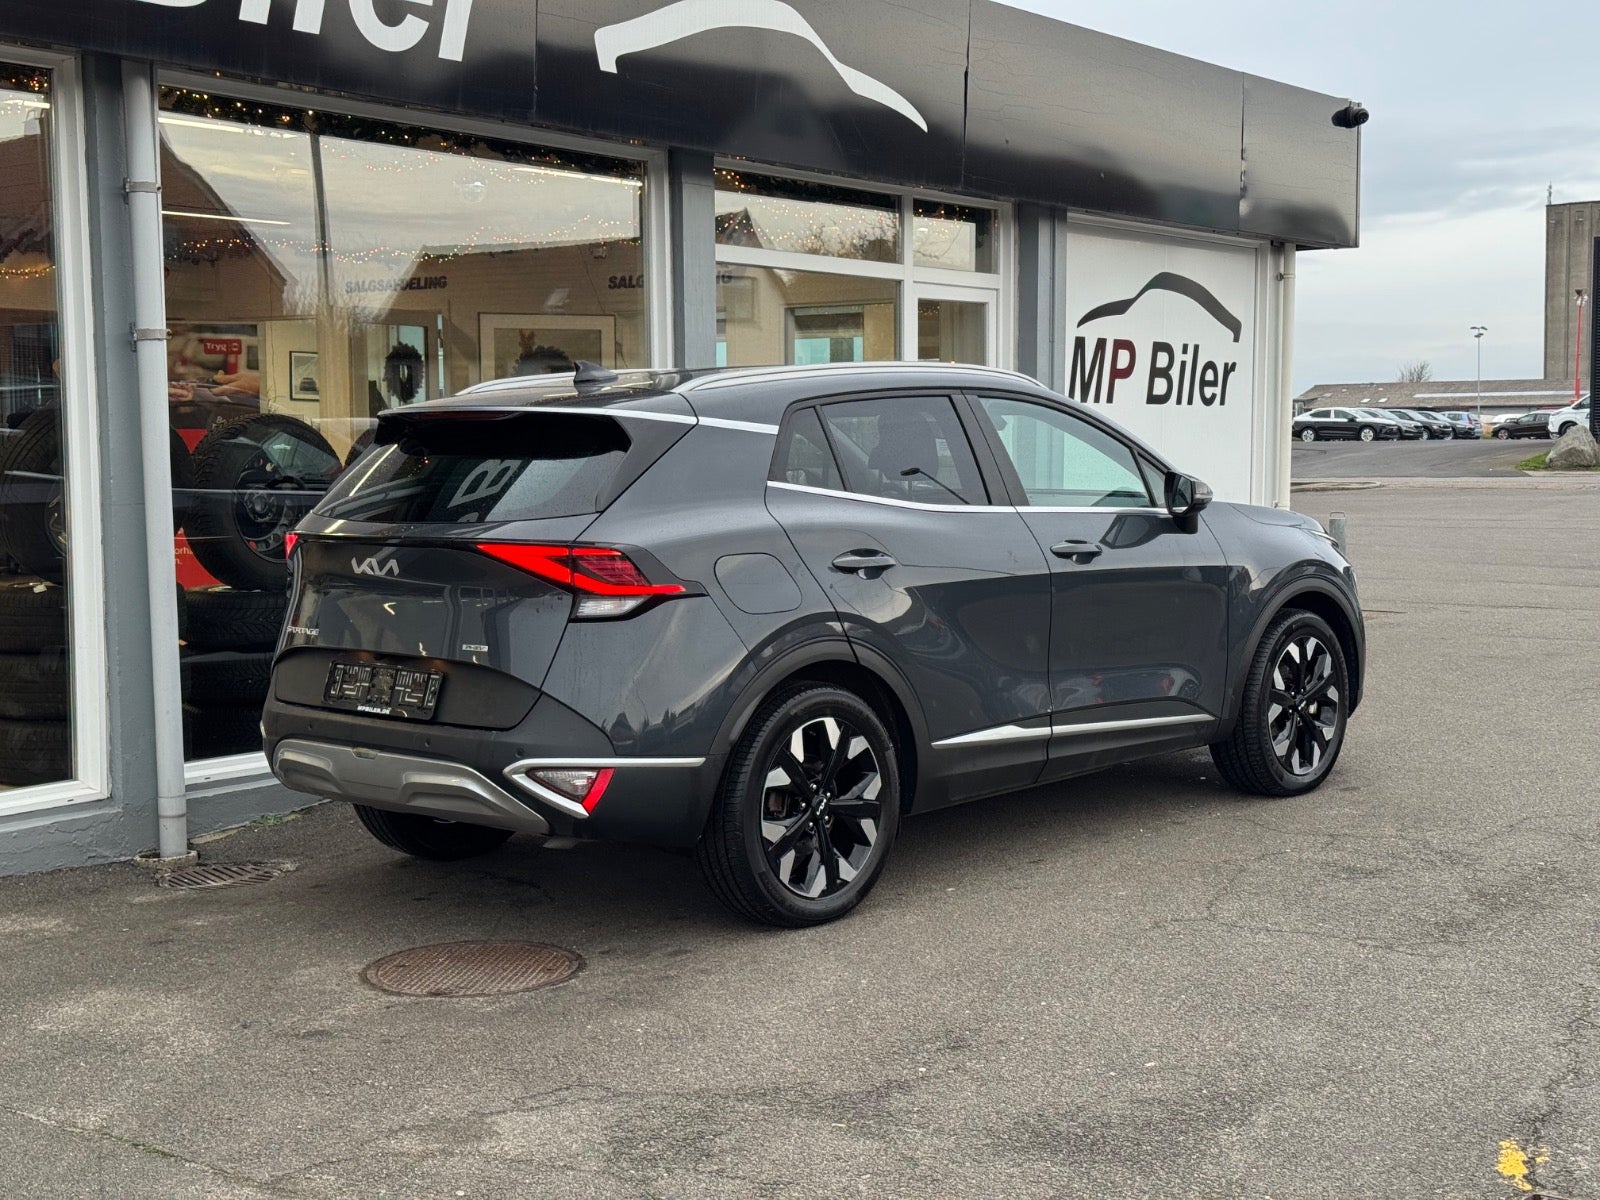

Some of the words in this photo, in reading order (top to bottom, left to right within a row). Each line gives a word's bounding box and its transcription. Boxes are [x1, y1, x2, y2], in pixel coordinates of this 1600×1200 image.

[205, 342, 228, 352] Tryg
[1068, 336, 1137, 404] MP
[1146, 341, 1238, 407] Biler
[351, 556, 400, 577] KIA
